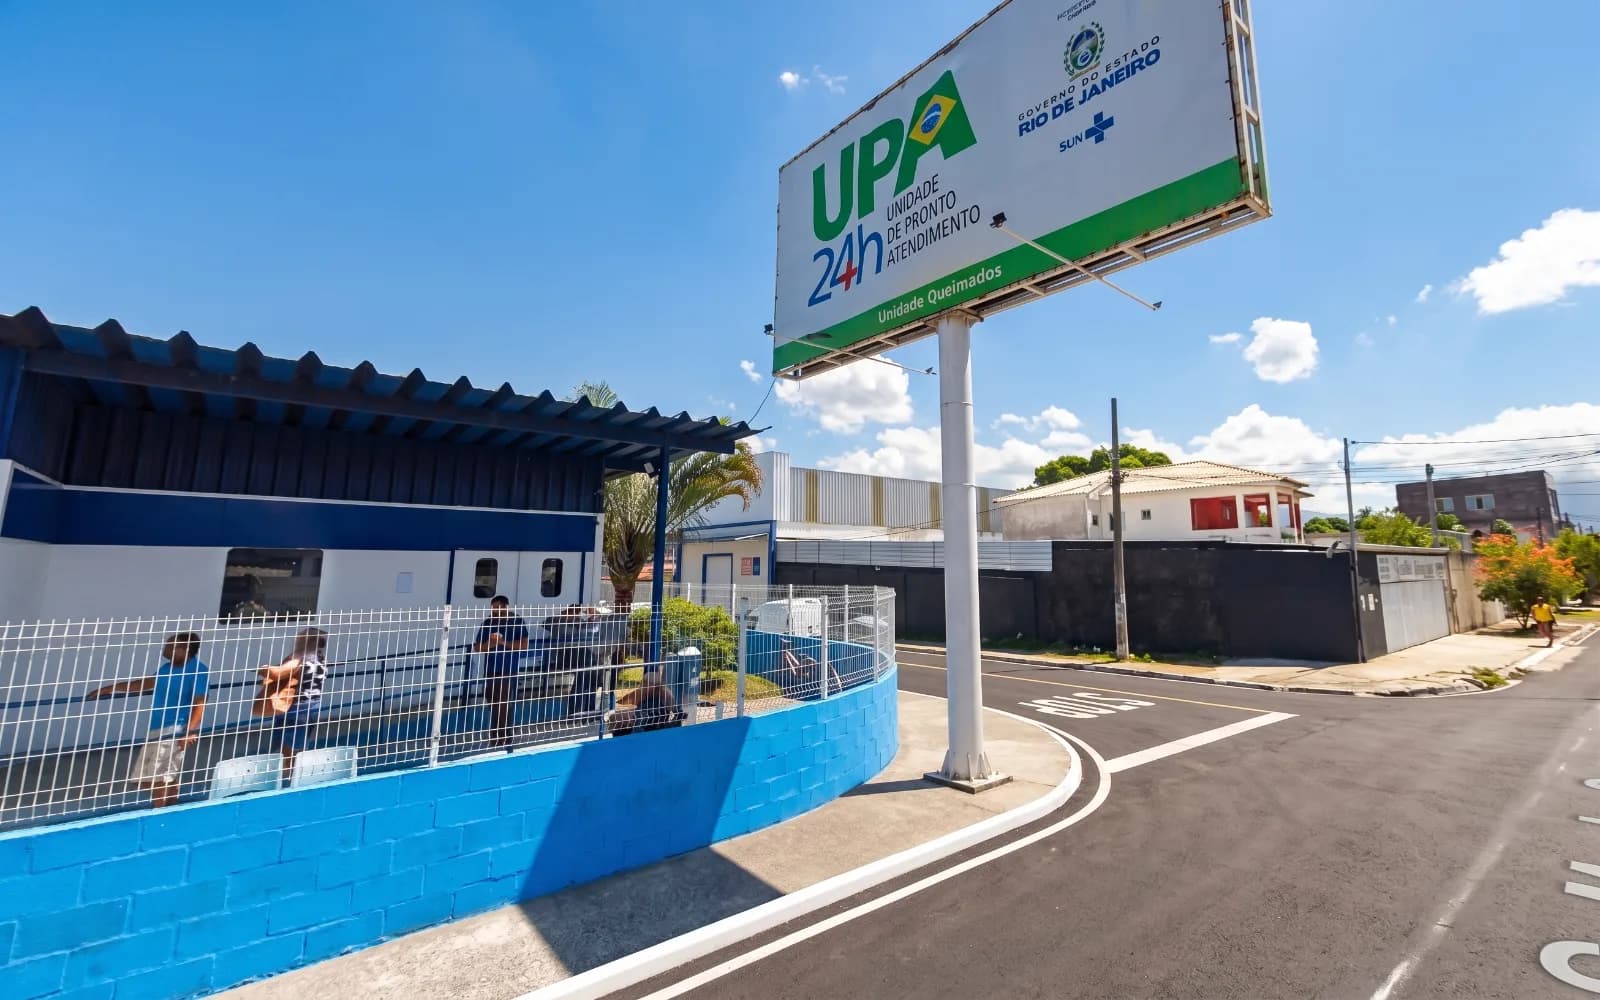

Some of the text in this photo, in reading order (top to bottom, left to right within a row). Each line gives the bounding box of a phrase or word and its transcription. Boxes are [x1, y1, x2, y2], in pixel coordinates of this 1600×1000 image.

[1018, 35, 1160, 121] GOVERNO DO ESTADO
[1018, 48, 1161, 137] RIO DE JANEIRO
[812, 70, 977, 242] UPA
[887, 173, 939, 222] UNIDADE
[887, 190, 956, 245] DE PRONTO
[807, 223, 884, 308] 24h
[887, 204, 981, 267] ATENDIMENTO
[878, 265, 1003, 324] Unidade Queimados
[1017, 692, 1157, 719] STOP
